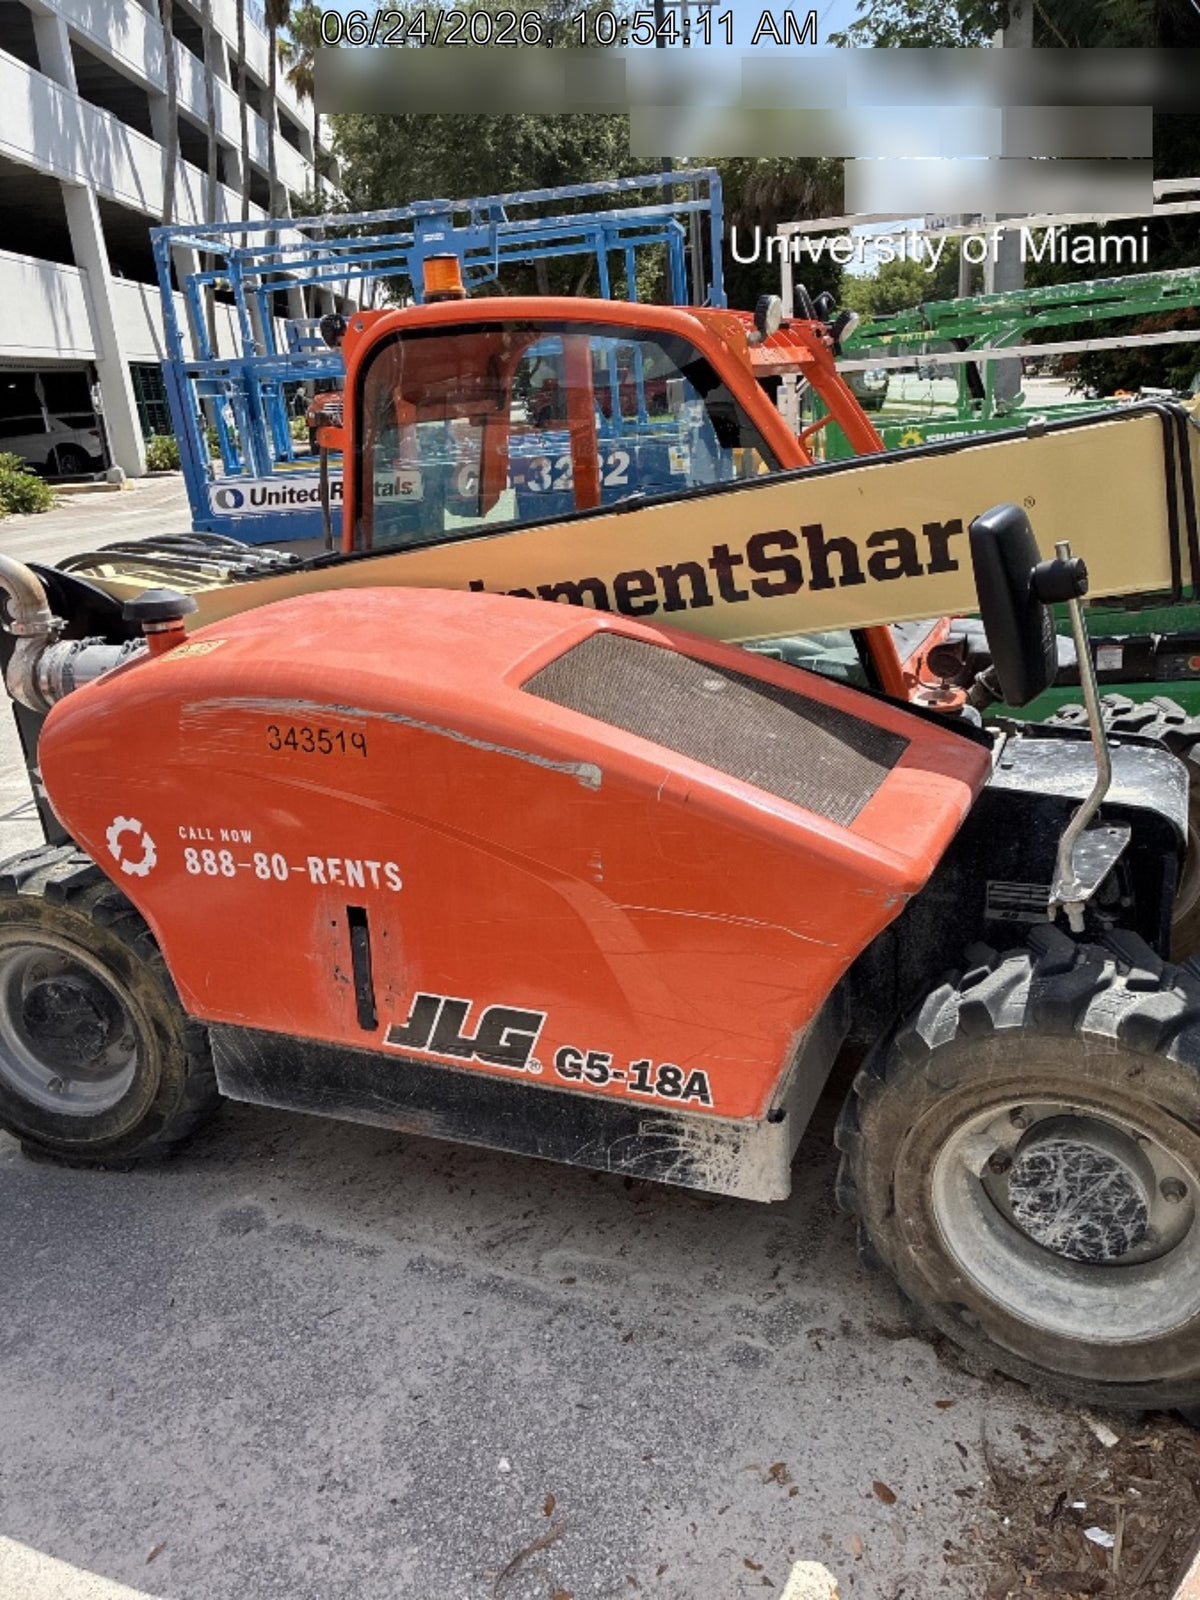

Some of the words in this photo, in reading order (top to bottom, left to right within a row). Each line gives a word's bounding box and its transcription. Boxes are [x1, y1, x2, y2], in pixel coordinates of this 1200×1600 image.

[330, 476, 413, 500] Rtals
[457, 451, 630, 498] G-322
[267, 724, 368, 758] 343519
[178, 826, 214, 841] CALL
[220, 828, 253, 844] NOW
[183, 847, 404, 892] 888-80-RENTS
[383, 991, 547, 1072] JLG
[554, 1045, 714, 1108] G5-18A
